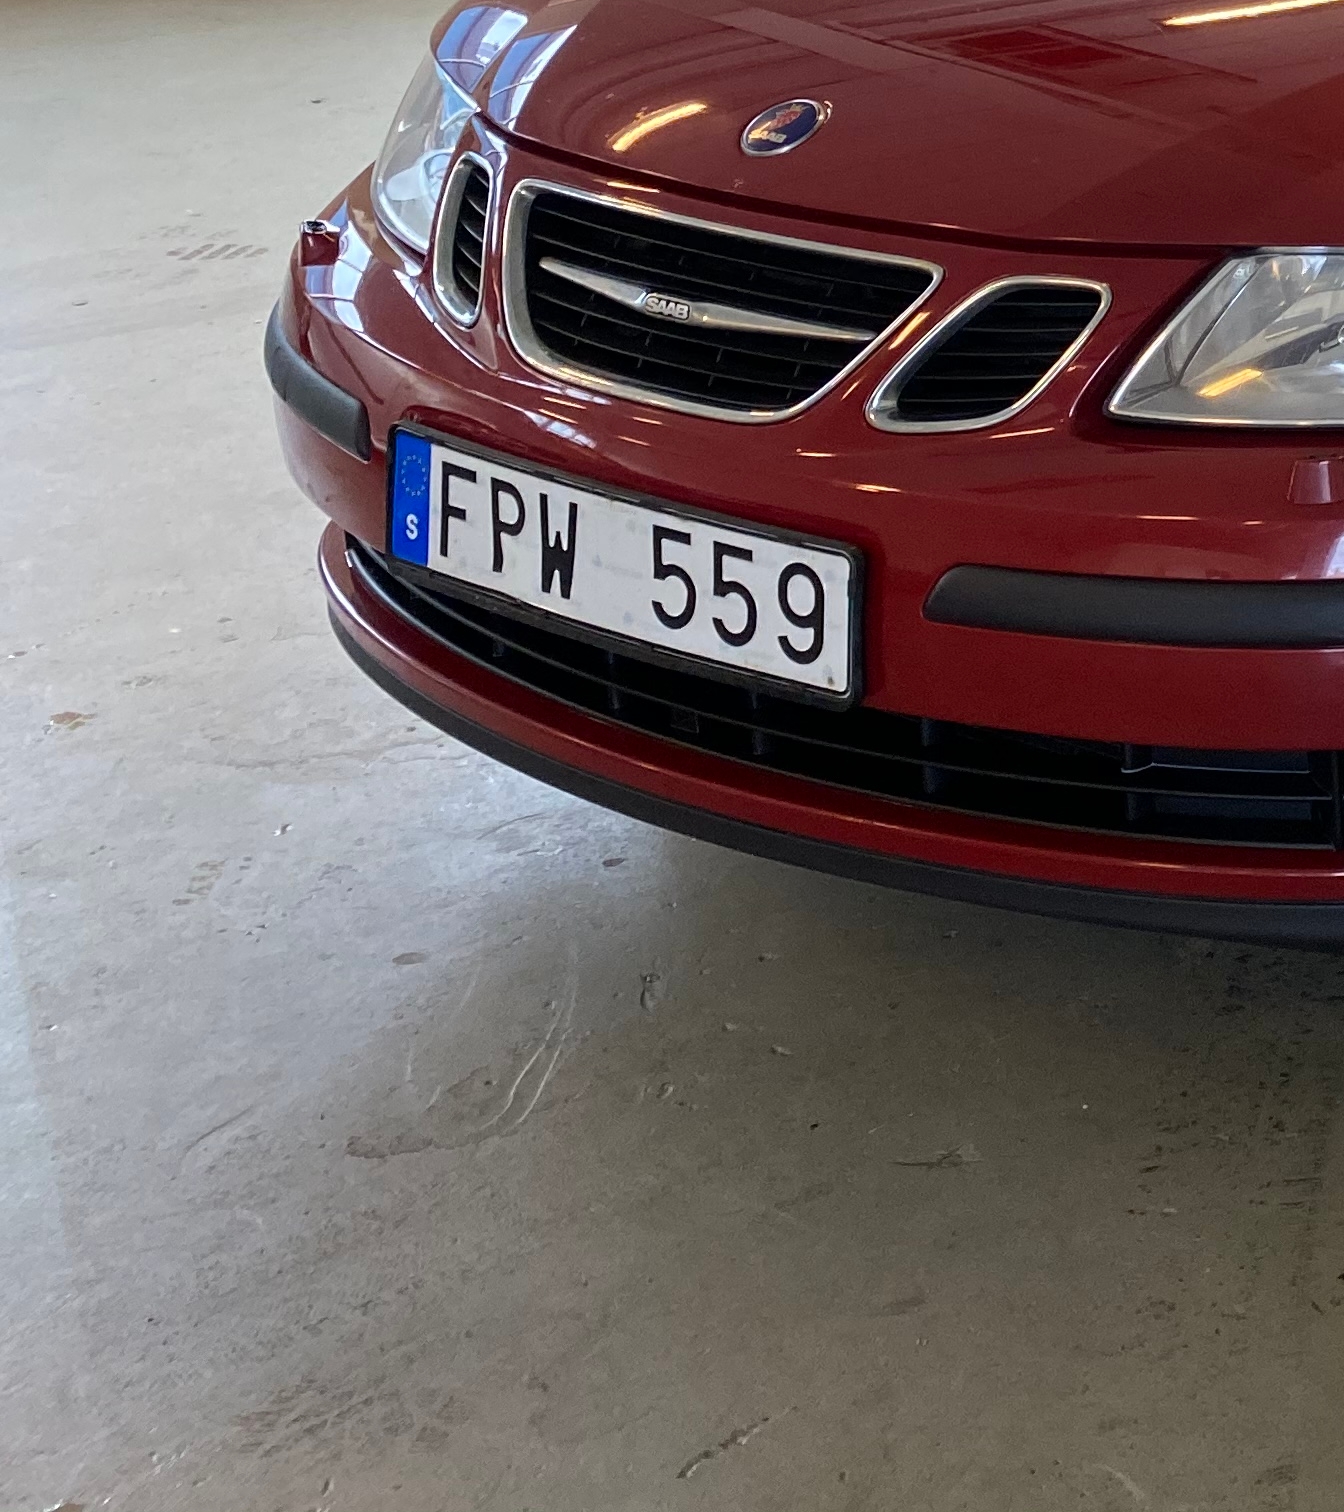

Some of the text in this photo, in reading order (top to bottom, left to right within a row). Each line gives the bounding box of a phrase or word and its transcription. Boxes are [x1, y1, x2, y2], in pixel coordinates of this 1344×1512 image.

[645, 296, 689, 320] SAAB
[406, 514, 419, 540] S
[439, 460, 825, 666] FPW 559
